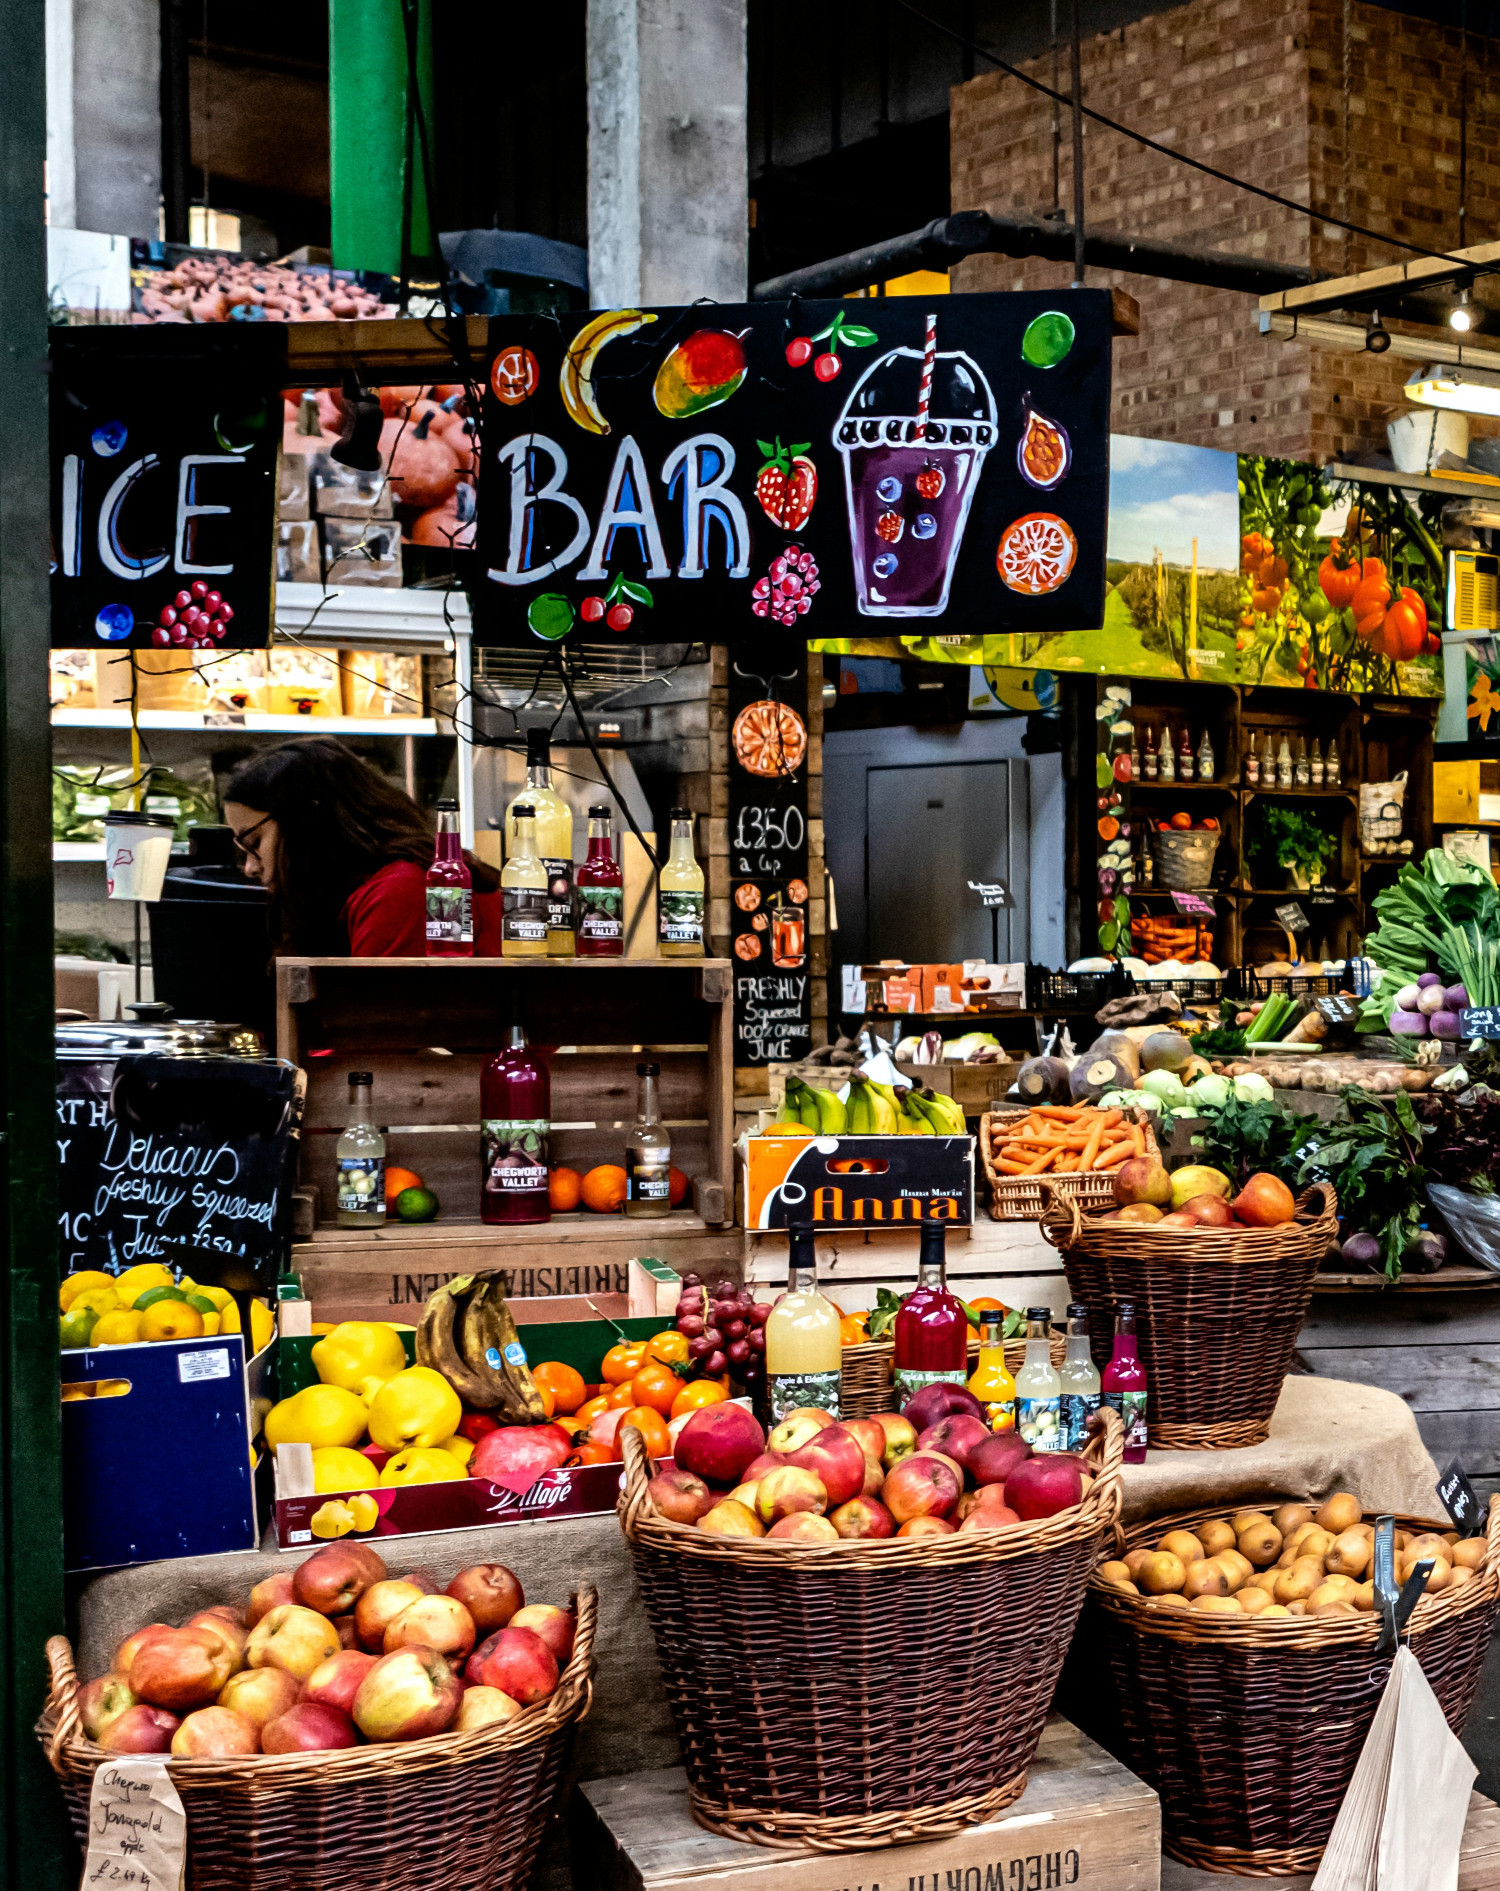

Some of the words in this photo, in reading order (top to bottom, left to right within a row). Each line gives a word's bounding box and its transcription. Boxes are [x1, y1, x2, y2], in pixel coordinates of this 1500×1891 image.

[58, 453, 246, 581] ICE
[488, 432, 750, 587] BAR
[740, 856, 752, 873] a
[737, 975, 807, 1001] FRESHLY
[739, 1024, 773, 1041] 100%
[748, 1039, 793, 1060] JUICE
[491, 1166, 548, 1177] CHEGWORTH
[502, 1177, 539, 1187] VALLEY
[812, 1186, 962, 1221] Anna
[901, 1188, 929, 1197] Anna
[931, 1188, 963, 1197] Maria
[503, 1263, 629, 1296] RRIETSHA
[90, 1859, 110, 1883] £
